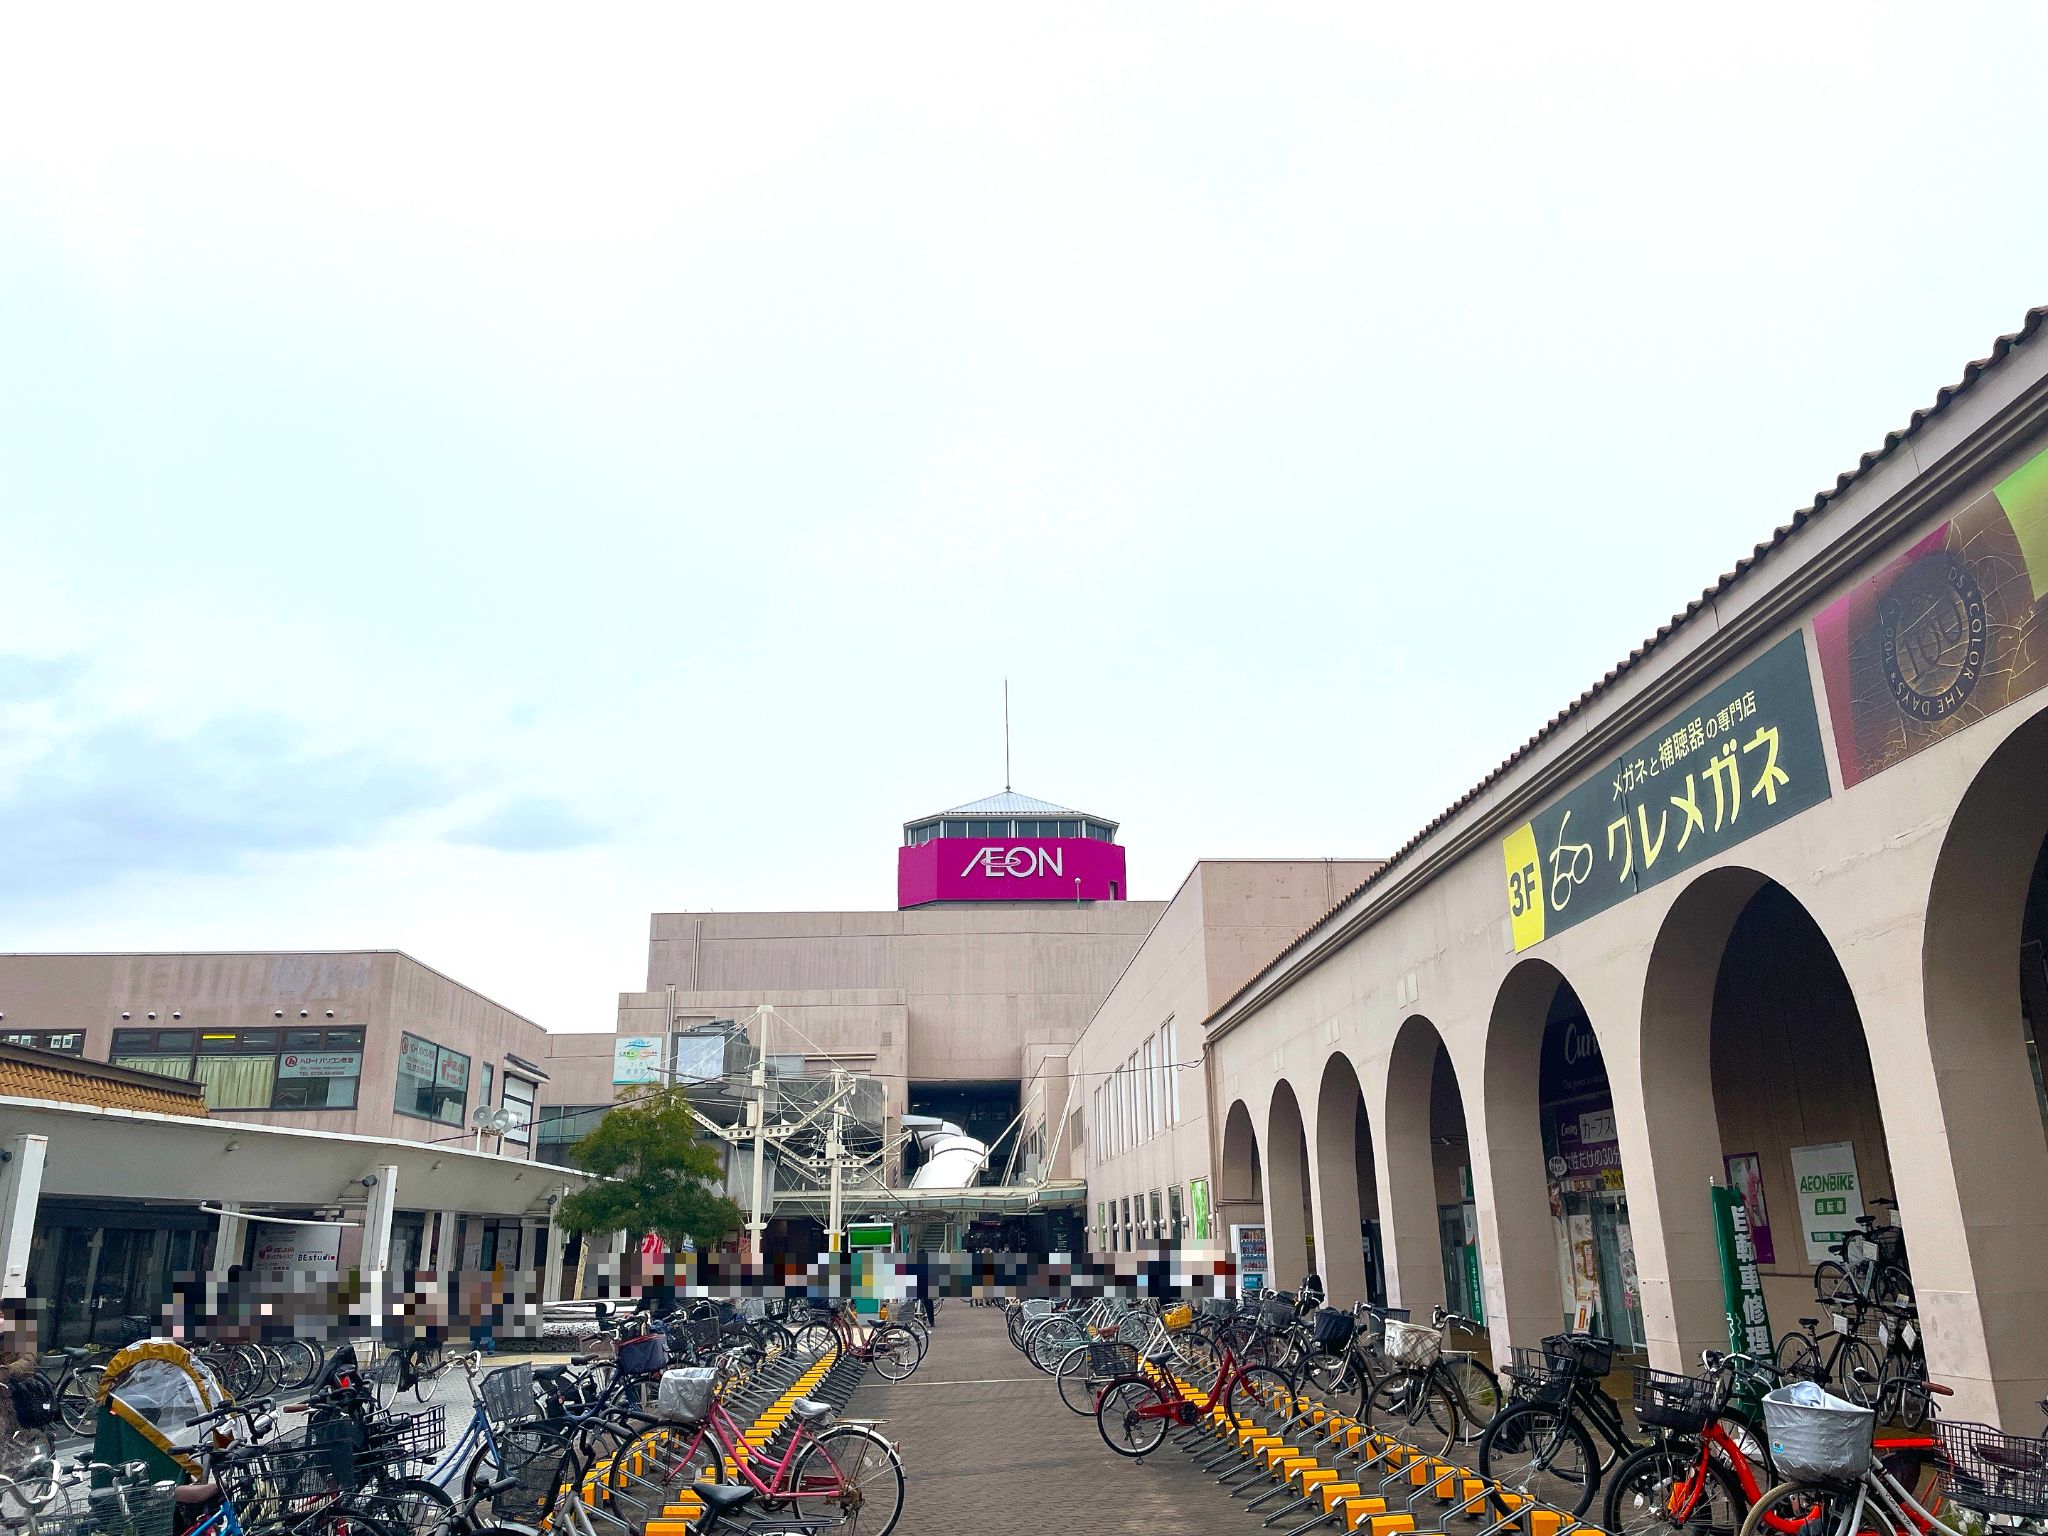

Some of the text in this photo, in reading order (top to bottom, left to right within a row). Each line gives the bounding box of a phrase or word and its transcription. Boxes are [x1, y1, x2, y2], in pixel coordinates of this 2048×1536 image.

[1896, 681, 1931, 716] DAYS
[1938, 685, 1964, 715] THE
[1612, 690, 1757, 802] メガネと補聴器の専門店
[1607, 726, 1790, 884] クレメガネ
[1509, 862, 1536, 917] 3F
[1800, 1173, 1855, 1194] AEONBIKE
